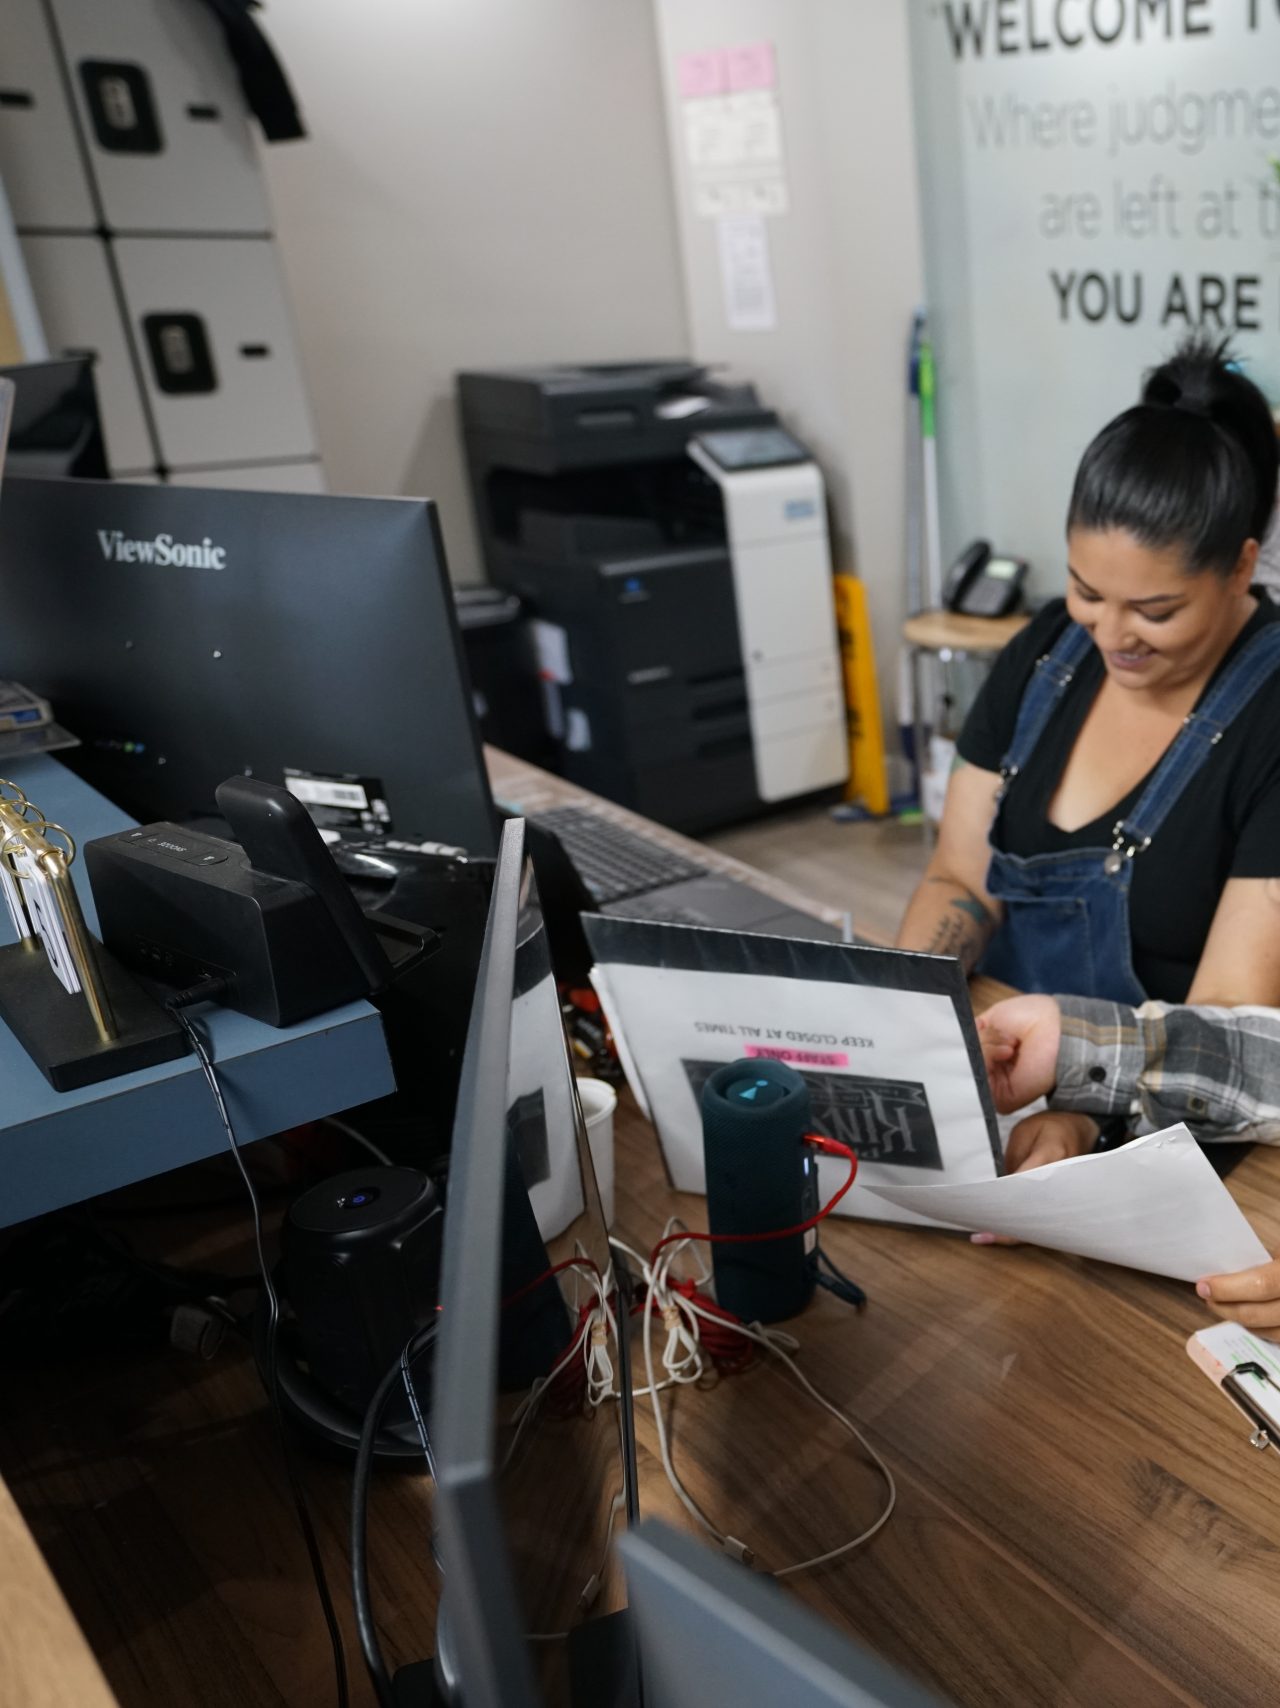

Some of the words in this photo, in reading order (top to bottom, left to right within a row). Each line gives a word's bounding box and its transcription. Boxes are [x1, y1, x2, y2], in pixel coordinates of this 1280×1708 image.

[965, 88, 1097, 150] Where
[1039, 191, 1102, 240] are
[1112, 173, 1182, 240] left
[1196, 179, 1243, 240] at
[1049, 268, 1142, 324] YOU
[1160, 270, 1260, 330] ARE
[98, 529, 227, 570] ViewSonic
[694, 1021, 737, 1035] TIMES
[739, 1025, 761, 1037] ALL
[766, 1028, 782, 1039] AT
[785, 1031, 837, 1045] CLOSED
[841, 1036, 875, 1048] KEEP
